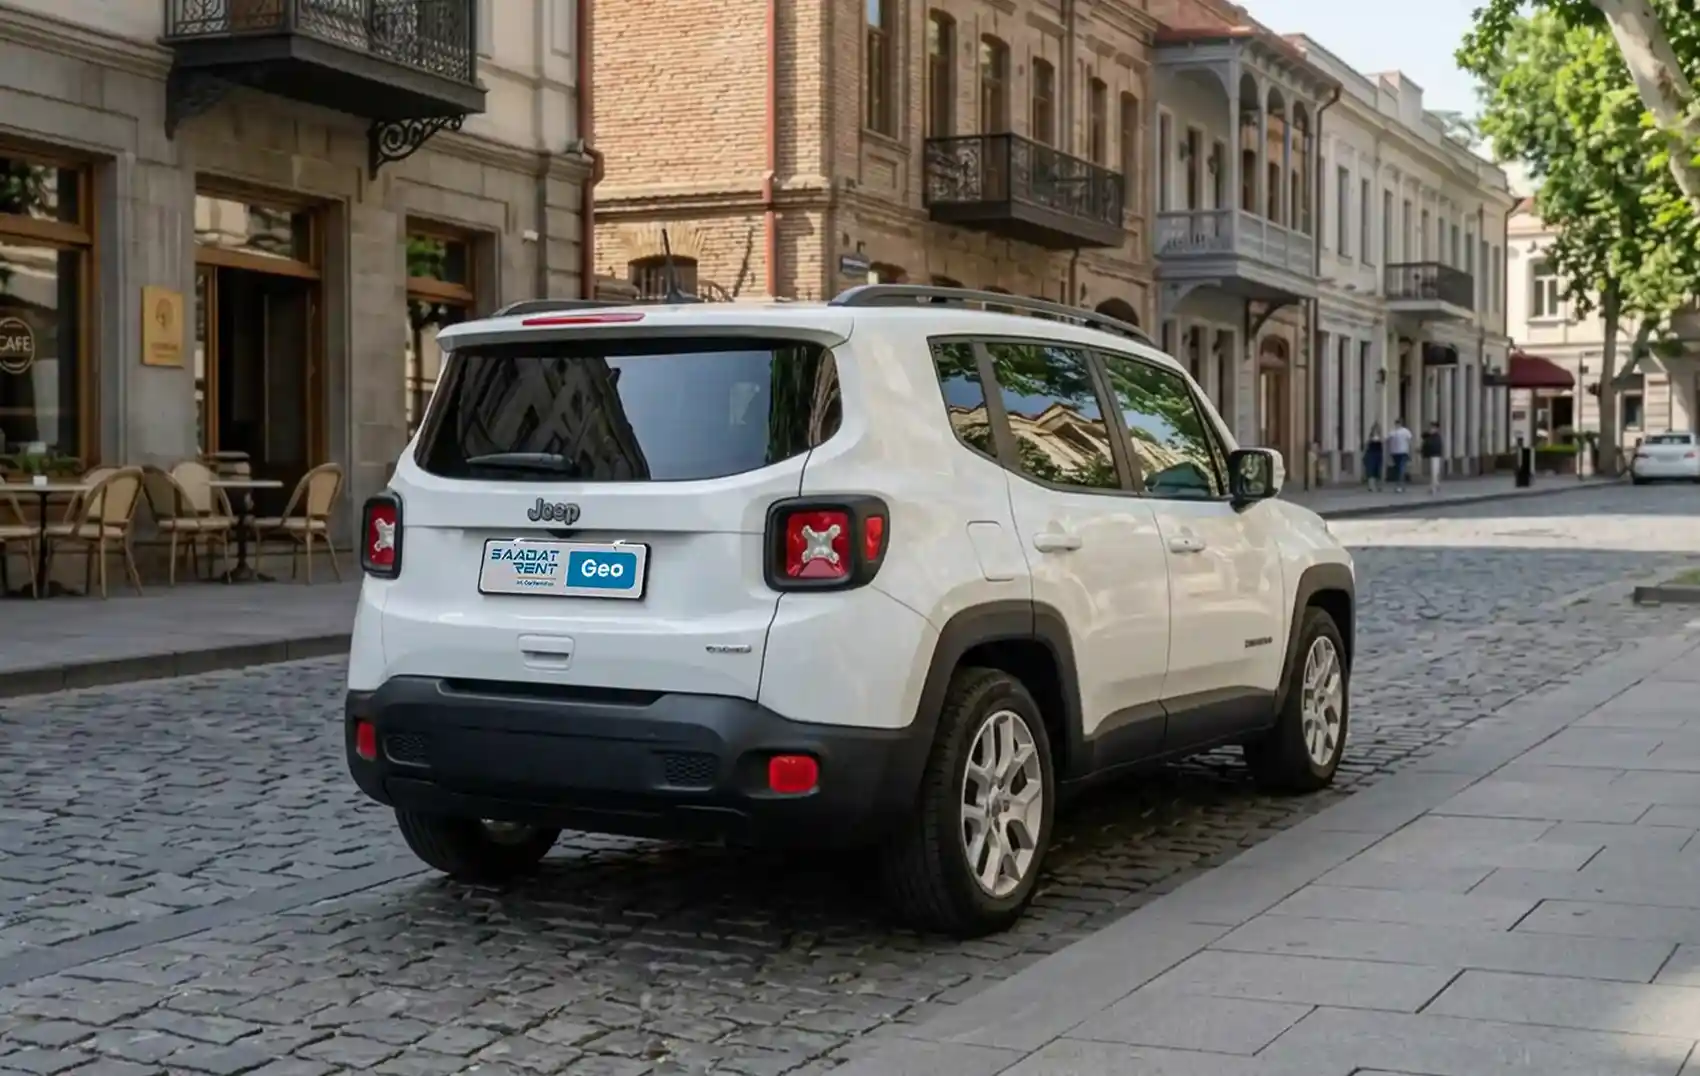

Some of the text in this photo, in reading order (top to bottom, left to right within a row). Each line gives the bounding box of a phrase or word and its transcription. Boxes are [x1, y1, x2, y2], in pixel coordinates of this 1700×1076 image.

[527, 497, 580, 525] Jeep
[491, 549, 560, 561] SAADAT
[513, 562, 558, 574] RENT
[581, 559, 624, 577] Geo
